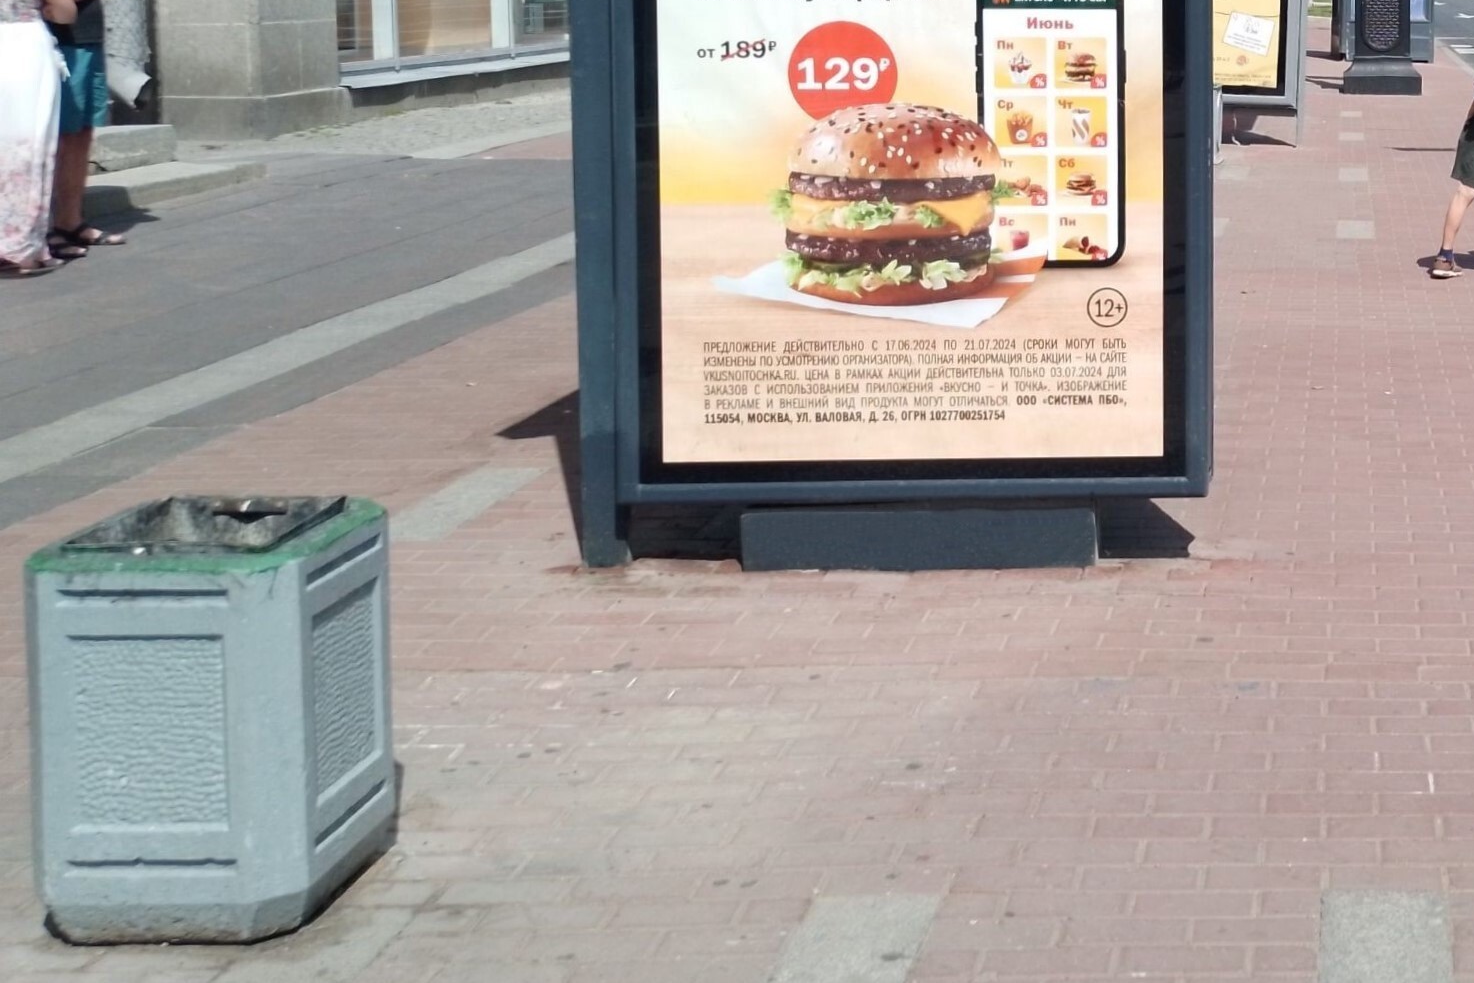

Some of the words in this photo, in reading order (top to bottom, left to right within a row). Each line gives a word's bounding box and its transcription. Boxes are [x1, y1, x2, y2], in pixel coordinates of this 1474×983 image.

[1026, 17, 1074, 29] Июнь
[697, 49, 715, 58] от
[997, 41, 1014, 51] Пн
[1058, 41, 1072, 50] Вт
[997, 99, 1013, 111] Ср
[1058, 99, 1073, 109] Чт
[1058, 157, 1075, 169] Сб
[999, 217, 1015, 227] Вс
[1060, 217, 1076, 227] Пн
[1095, 298, 1124, 318] 12+
[704, 341, 776, 353] ПРЕДЛОЖЕНИЕ
[783, 339, 864, 353] ДЕЙСТВИТЕЛЬНО
[944, 339, 956, 350] ПО
[965, 339, 1016, 350] 21.07.2024
[1023, 338, 1057, 351] (СРОКИ
[1065, 338, 1094, 349] МОГУТ
[1102, 338, 1127, 349] БЫТЬ
[704, 356, 756, 367] ИЗМЕНЕНЫ
[760, 356, 773, 366] ПО
[776, 355, 839, 367] УСМОТРЕНИЮ
[918, 354, 954, 365] ПОЛНАЯ
[957, 353, 1022, 366] ИНФОРМАЦИЯ
[1025, 353, 1038, 364] ОБ
[1041, 353, 1071, 365] АКЦИИ
[1085, 352, 1097, 363] НА
[1100, 350, 1127, 363] САЙТЕ
[805, 369, 829, 382] ЦЕНА
[846, 369, 883, 380] РАМКАХ
[888, 368, 920, 380] АКЦИИ
[926, 366, 1003, 380] ДЕЙСТВИТЕЛЬНА
[1009, 367, 1045, 378] ТОЛЬКО
[1050, 367, 1101, 378] 03.07.2024
[1107, 367, 1127, 379] ДЛЯ
[704, 385, 747, 395] ЗАКАЗОВ
[767, 384, 859, 395] ИСПОЛЬЗОВАНИЕМ
[866, 382, 933, 394] ПРИЛОЖЕНИЯ
[1056, 380, 1127, 391] ИЗОБРАЖЕНИЕ
[716, 399, 760, 410] РЕКЛАМЕ
[779, 396, 829, 409] ВНЕШНИЙ
[835, 398, 856, 410] ВИД
[861, 397, 908, 409] ПРОДУКТА
[914, 396, 944, 407] МОГУТ
[1016, 395, 1037, 406] ООО
[1042, 394, 1093, 406] «СИСТЕМА
[704, 414, 744, 425] 115054,
[747, 413, 793, 424] МОСКВА,
[796, 412, 810, 423] УЛ.
[815, 412, 865, 423] ВАЛОВАЯ,
[882, 411, 898, 422] 26,
[901, 410, 926, 421] ОГРН
[930, 410, 1005, 421] 1027700251754
